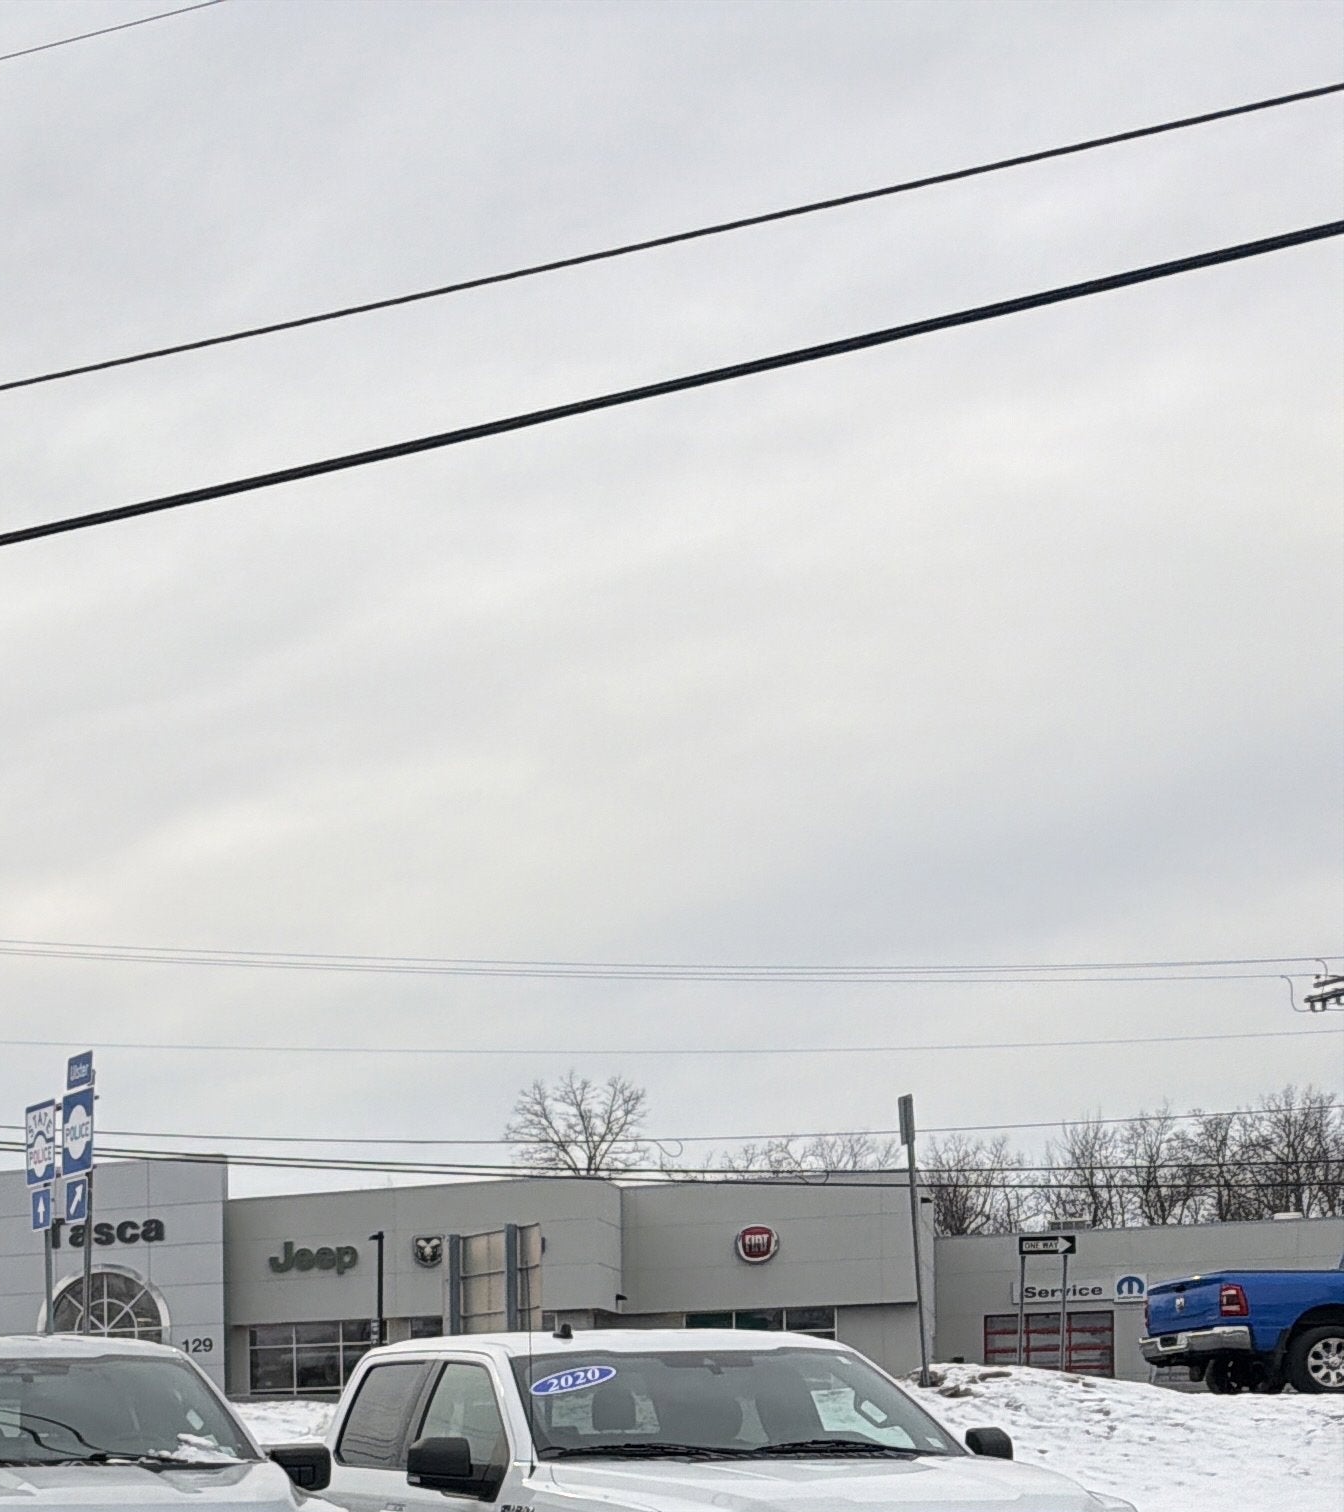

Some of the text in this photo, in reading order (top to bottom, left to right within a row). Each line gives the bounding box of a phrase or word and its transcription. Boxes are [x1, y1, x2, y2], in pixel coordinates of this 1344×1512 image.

[28, 1111, 53, 1139] STATE
[66, 1120, 90, 1142] POLICE
[29, 1145, 52, 1165] POLICE
[745, 1234, 769, 1252] FIAT
[1024, 1240, 1058, 1249] ONE WAY
[269, 1241, 359, 1275] Jeep
[181, 1338, 213, 1353] 129
[546, 1368, 600, 1392] 2020
